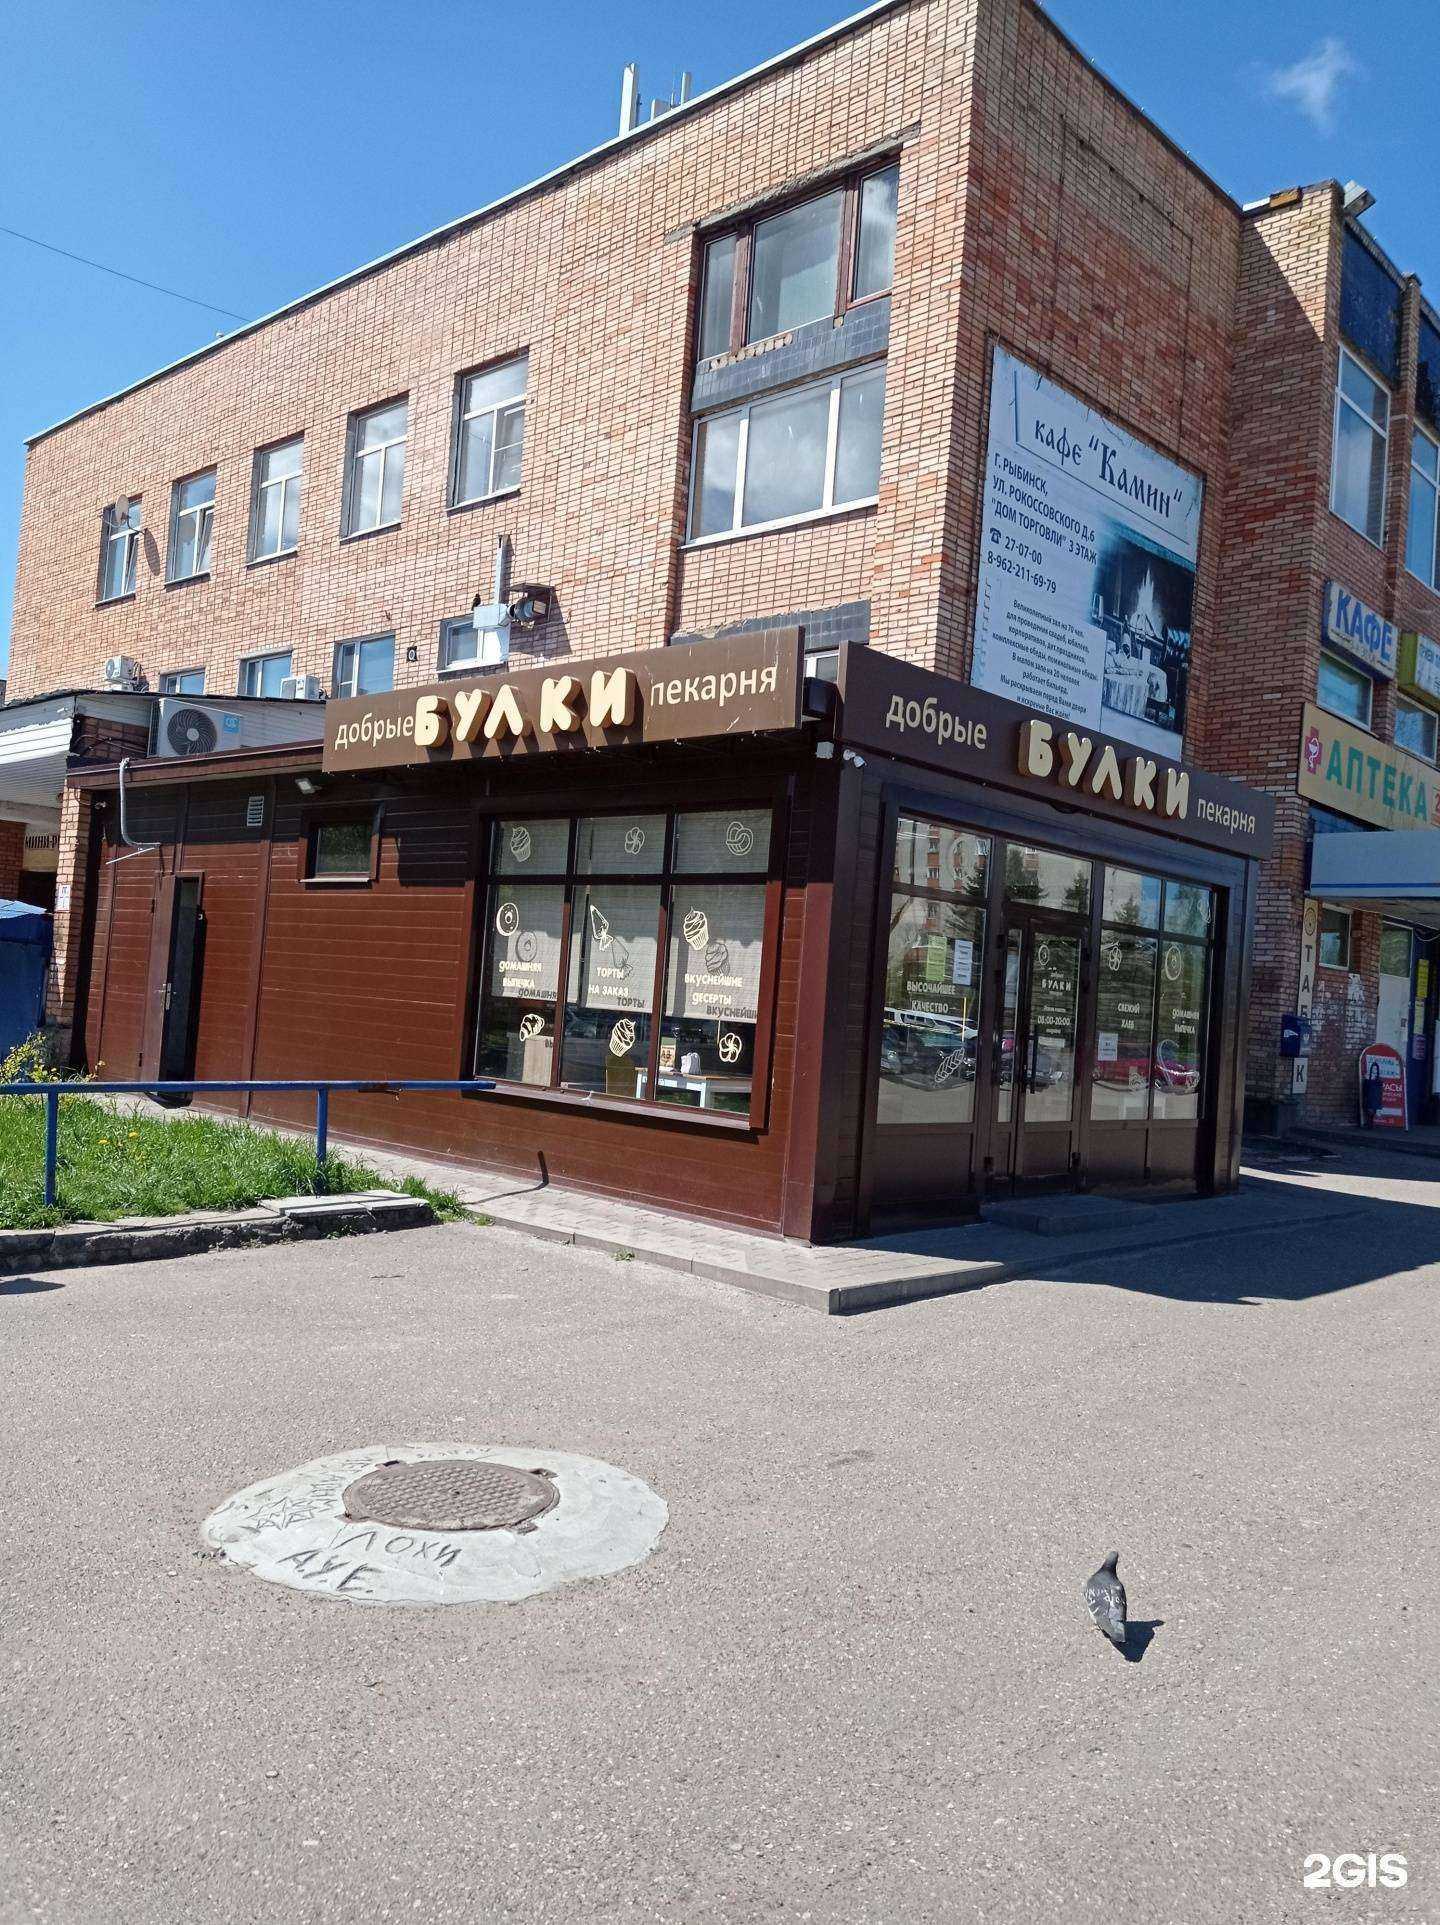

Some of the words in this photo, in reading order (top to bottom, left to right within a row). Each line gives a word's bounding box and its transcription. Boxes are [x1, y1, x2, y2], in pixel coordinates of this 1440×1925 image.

[1003, 458, 1048, 496] РЫБИНСК,
[1035, 420, 1082, 466] кафе
[1088, 435, 1183, 518] "Камин"
[993, 475, 1007, 495] УЛ.
[1009, 485, 1081, 534] РОКОССОВСКОГО
[991, 498, 1017, 523] "ДОМ
[1019, 512, 1067, 547] ТОРГОВЛИ"
[1068, 540, 1074, 553] 3
[1075, 543, 1097, 565] ЭТАЖ
[1004, 536, 1042, 565] 27-07-00
[987, 551, 1057, 593] 8-962-211-69-79
[1335, 589, 1393, 662] КАФЕ
[334, 713, 414, 750] добрые
[414, 666, 637, 747] БУЛКИ
[650, 661, 778, 707] пекарня
[885, 694, 987, 750] добрые
[1018, 719, 1190, 820] БУЛКИ
[1197, 798, 1256, 835] пекарня
[1325, 739, 1428, 823] АПТЕКА
[588, 984, 600, 994] НА
[602, 985, 629, 997] ЗАКАЗ
[596, 967, 624, 979] ТОРТЫ
[1041, 979, 1071, 991] БУЛКИ
[334, 1529, 462, 1567] ЛОХИ
